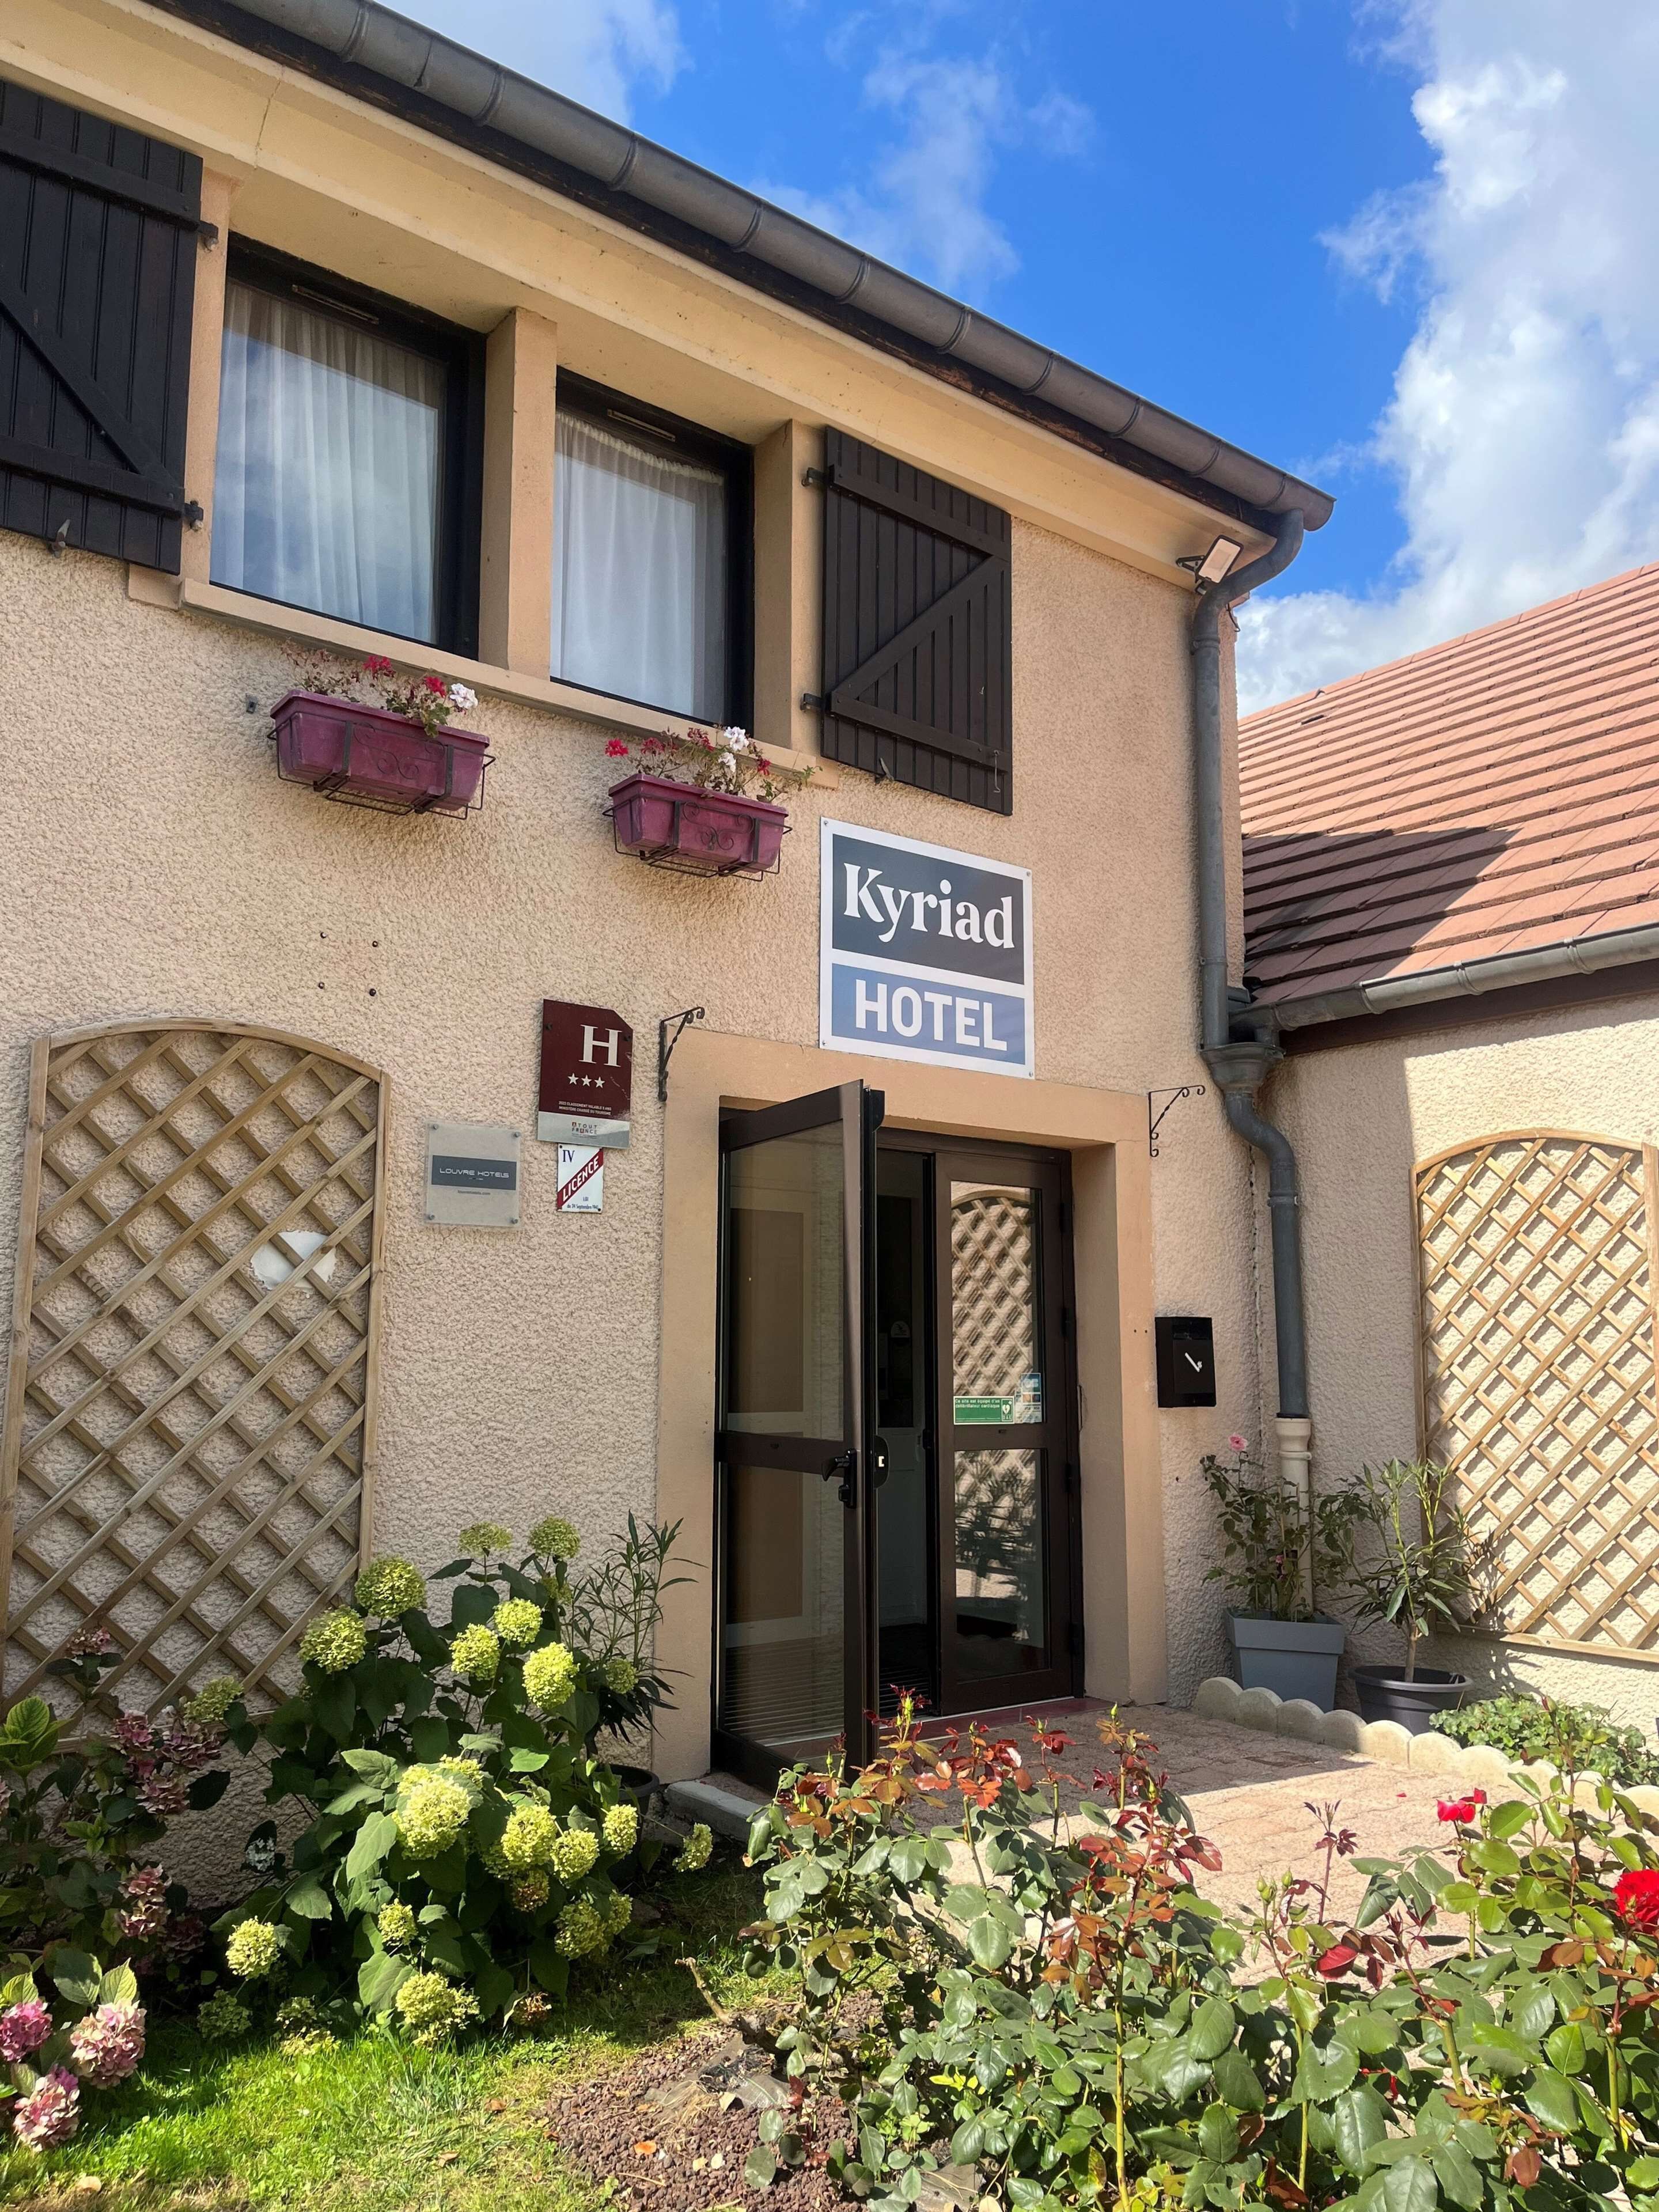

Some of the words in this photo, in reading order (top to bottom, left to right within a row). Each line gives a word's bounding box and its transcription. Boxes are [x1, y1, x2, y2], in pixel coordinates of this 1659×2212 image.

[843, 862, 1015, 949] Kyriad
[855, 979, 1007, 1051] HOTEL
[578, 1024, 622, 1067] H
[440, 1168, 475, 1176] LOUVRE
[563, 1150, 575, 1162] IV
[563, 1156, 599, 1202] LICENCE
